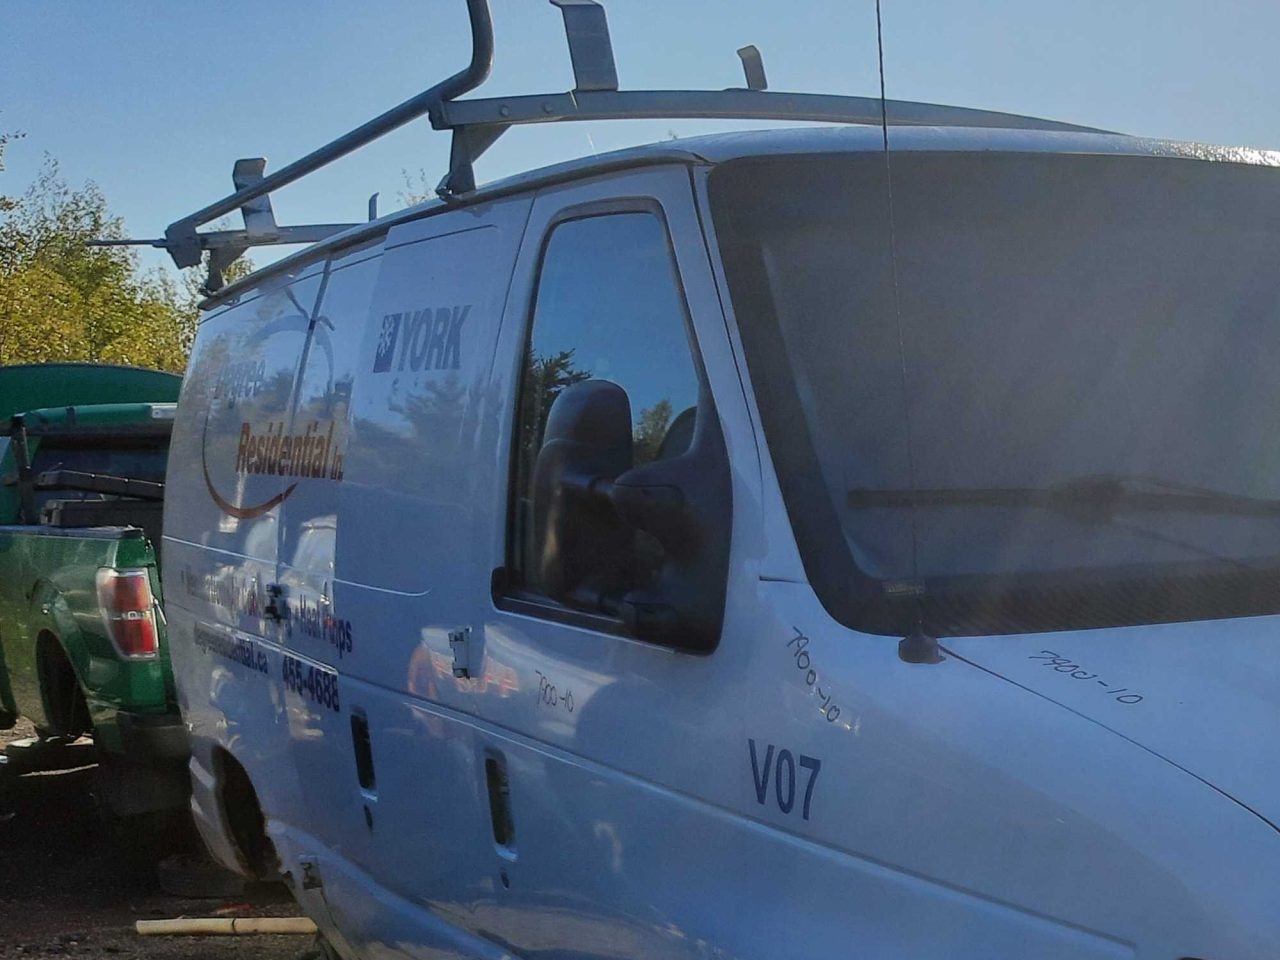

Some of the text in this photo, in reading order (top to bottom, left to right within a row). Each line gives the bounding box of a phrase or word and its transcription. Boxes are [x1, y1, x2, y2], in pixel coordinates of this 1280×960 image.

[397, 304, 473, 373] YORK
[236, 421, 335, 479] Residential
[747, 737, 822, 821] V07
